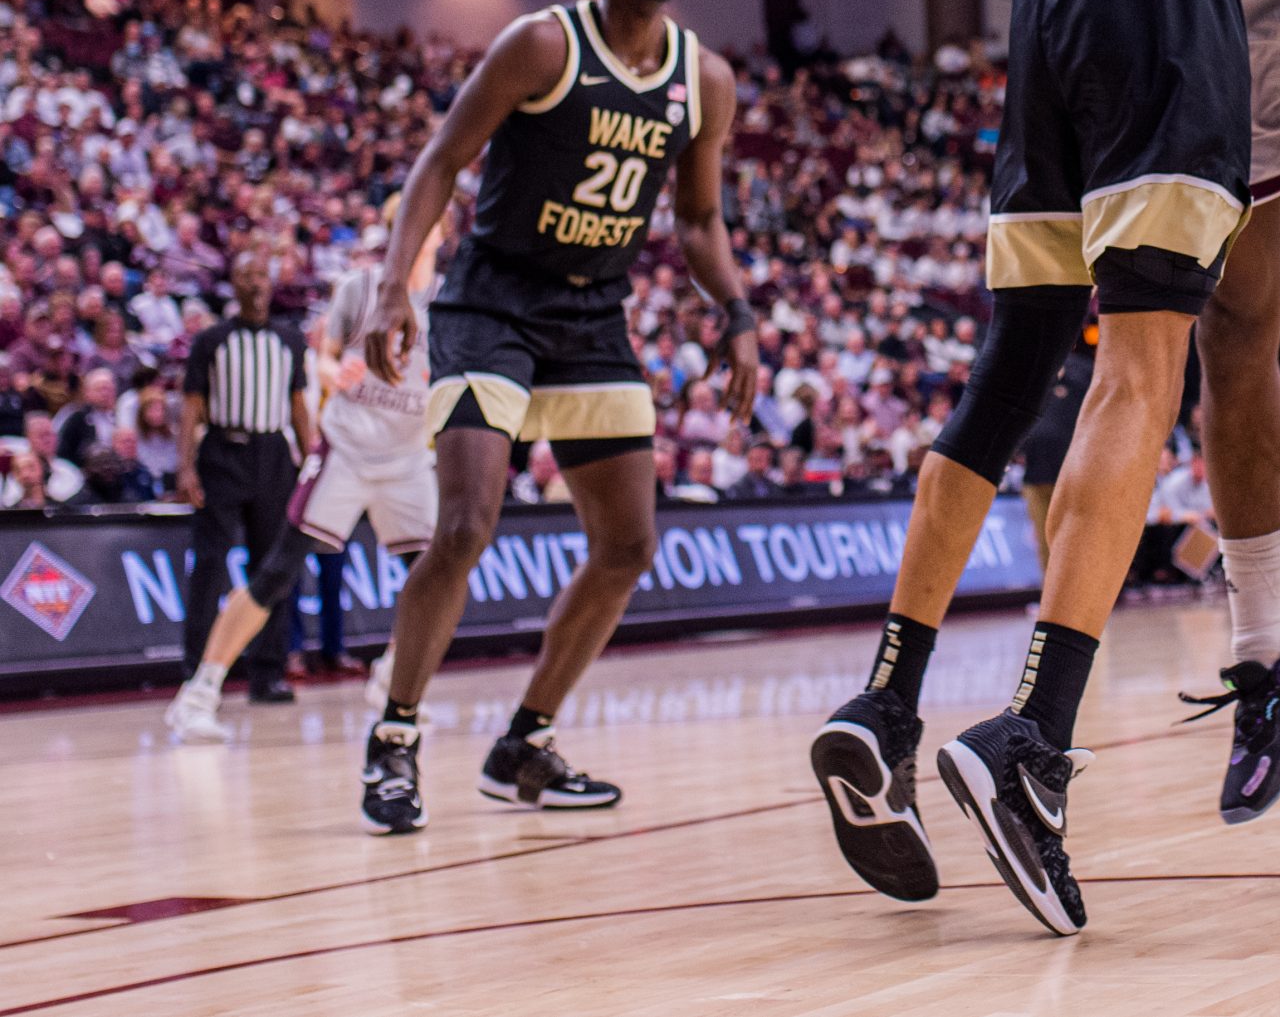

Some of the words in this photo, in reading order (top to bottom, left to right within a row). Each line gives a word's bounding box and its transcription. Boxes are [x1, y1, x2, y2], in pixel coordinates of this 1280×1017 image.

[588, 106, 673, 160] WAKE
[572, 150, 648, 213] 20
[536, 199, 645, 249] FOREST
